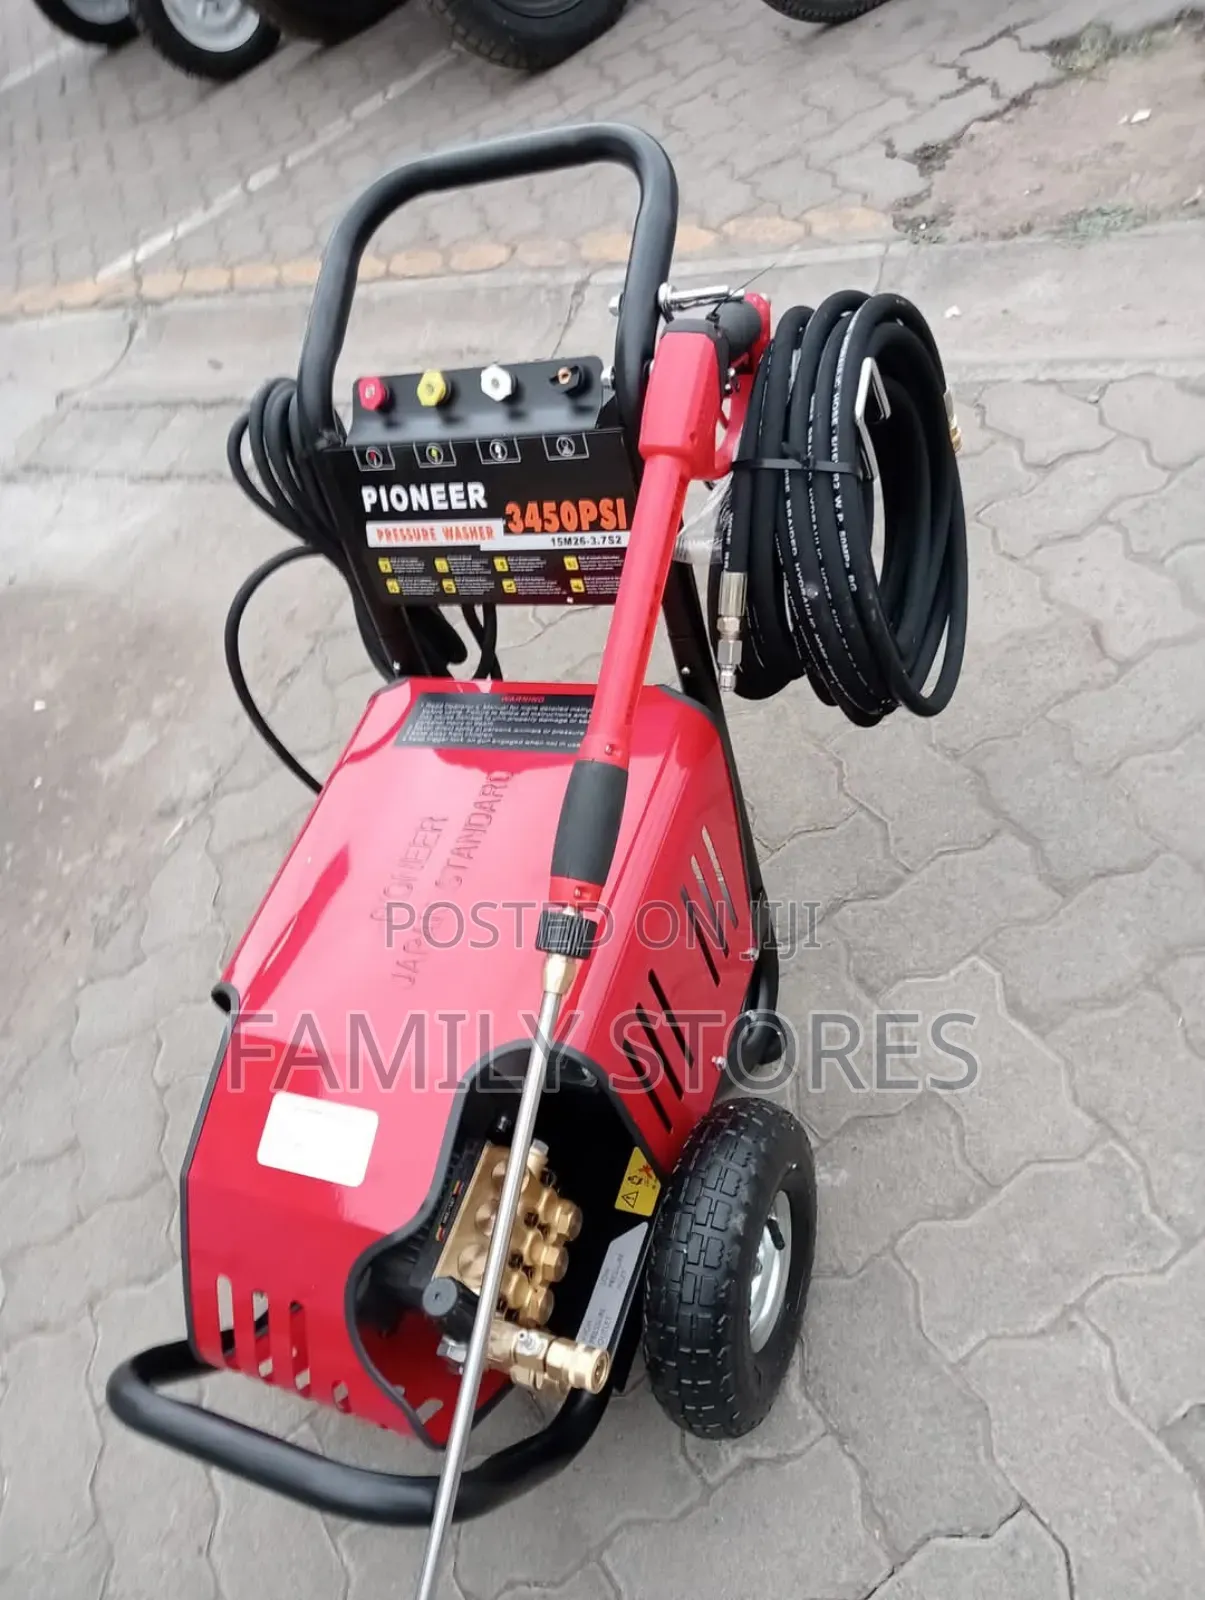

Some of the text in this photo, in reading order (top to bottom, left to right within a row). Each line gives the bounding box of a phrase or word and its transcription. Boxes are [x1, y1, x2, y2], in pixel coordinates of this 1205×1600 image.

[361, 481, 488, 513] PIONEER
[505, 497, 627, 534] 3450PSI
[376, 525, 494, 542] PRESSURE WASHER
